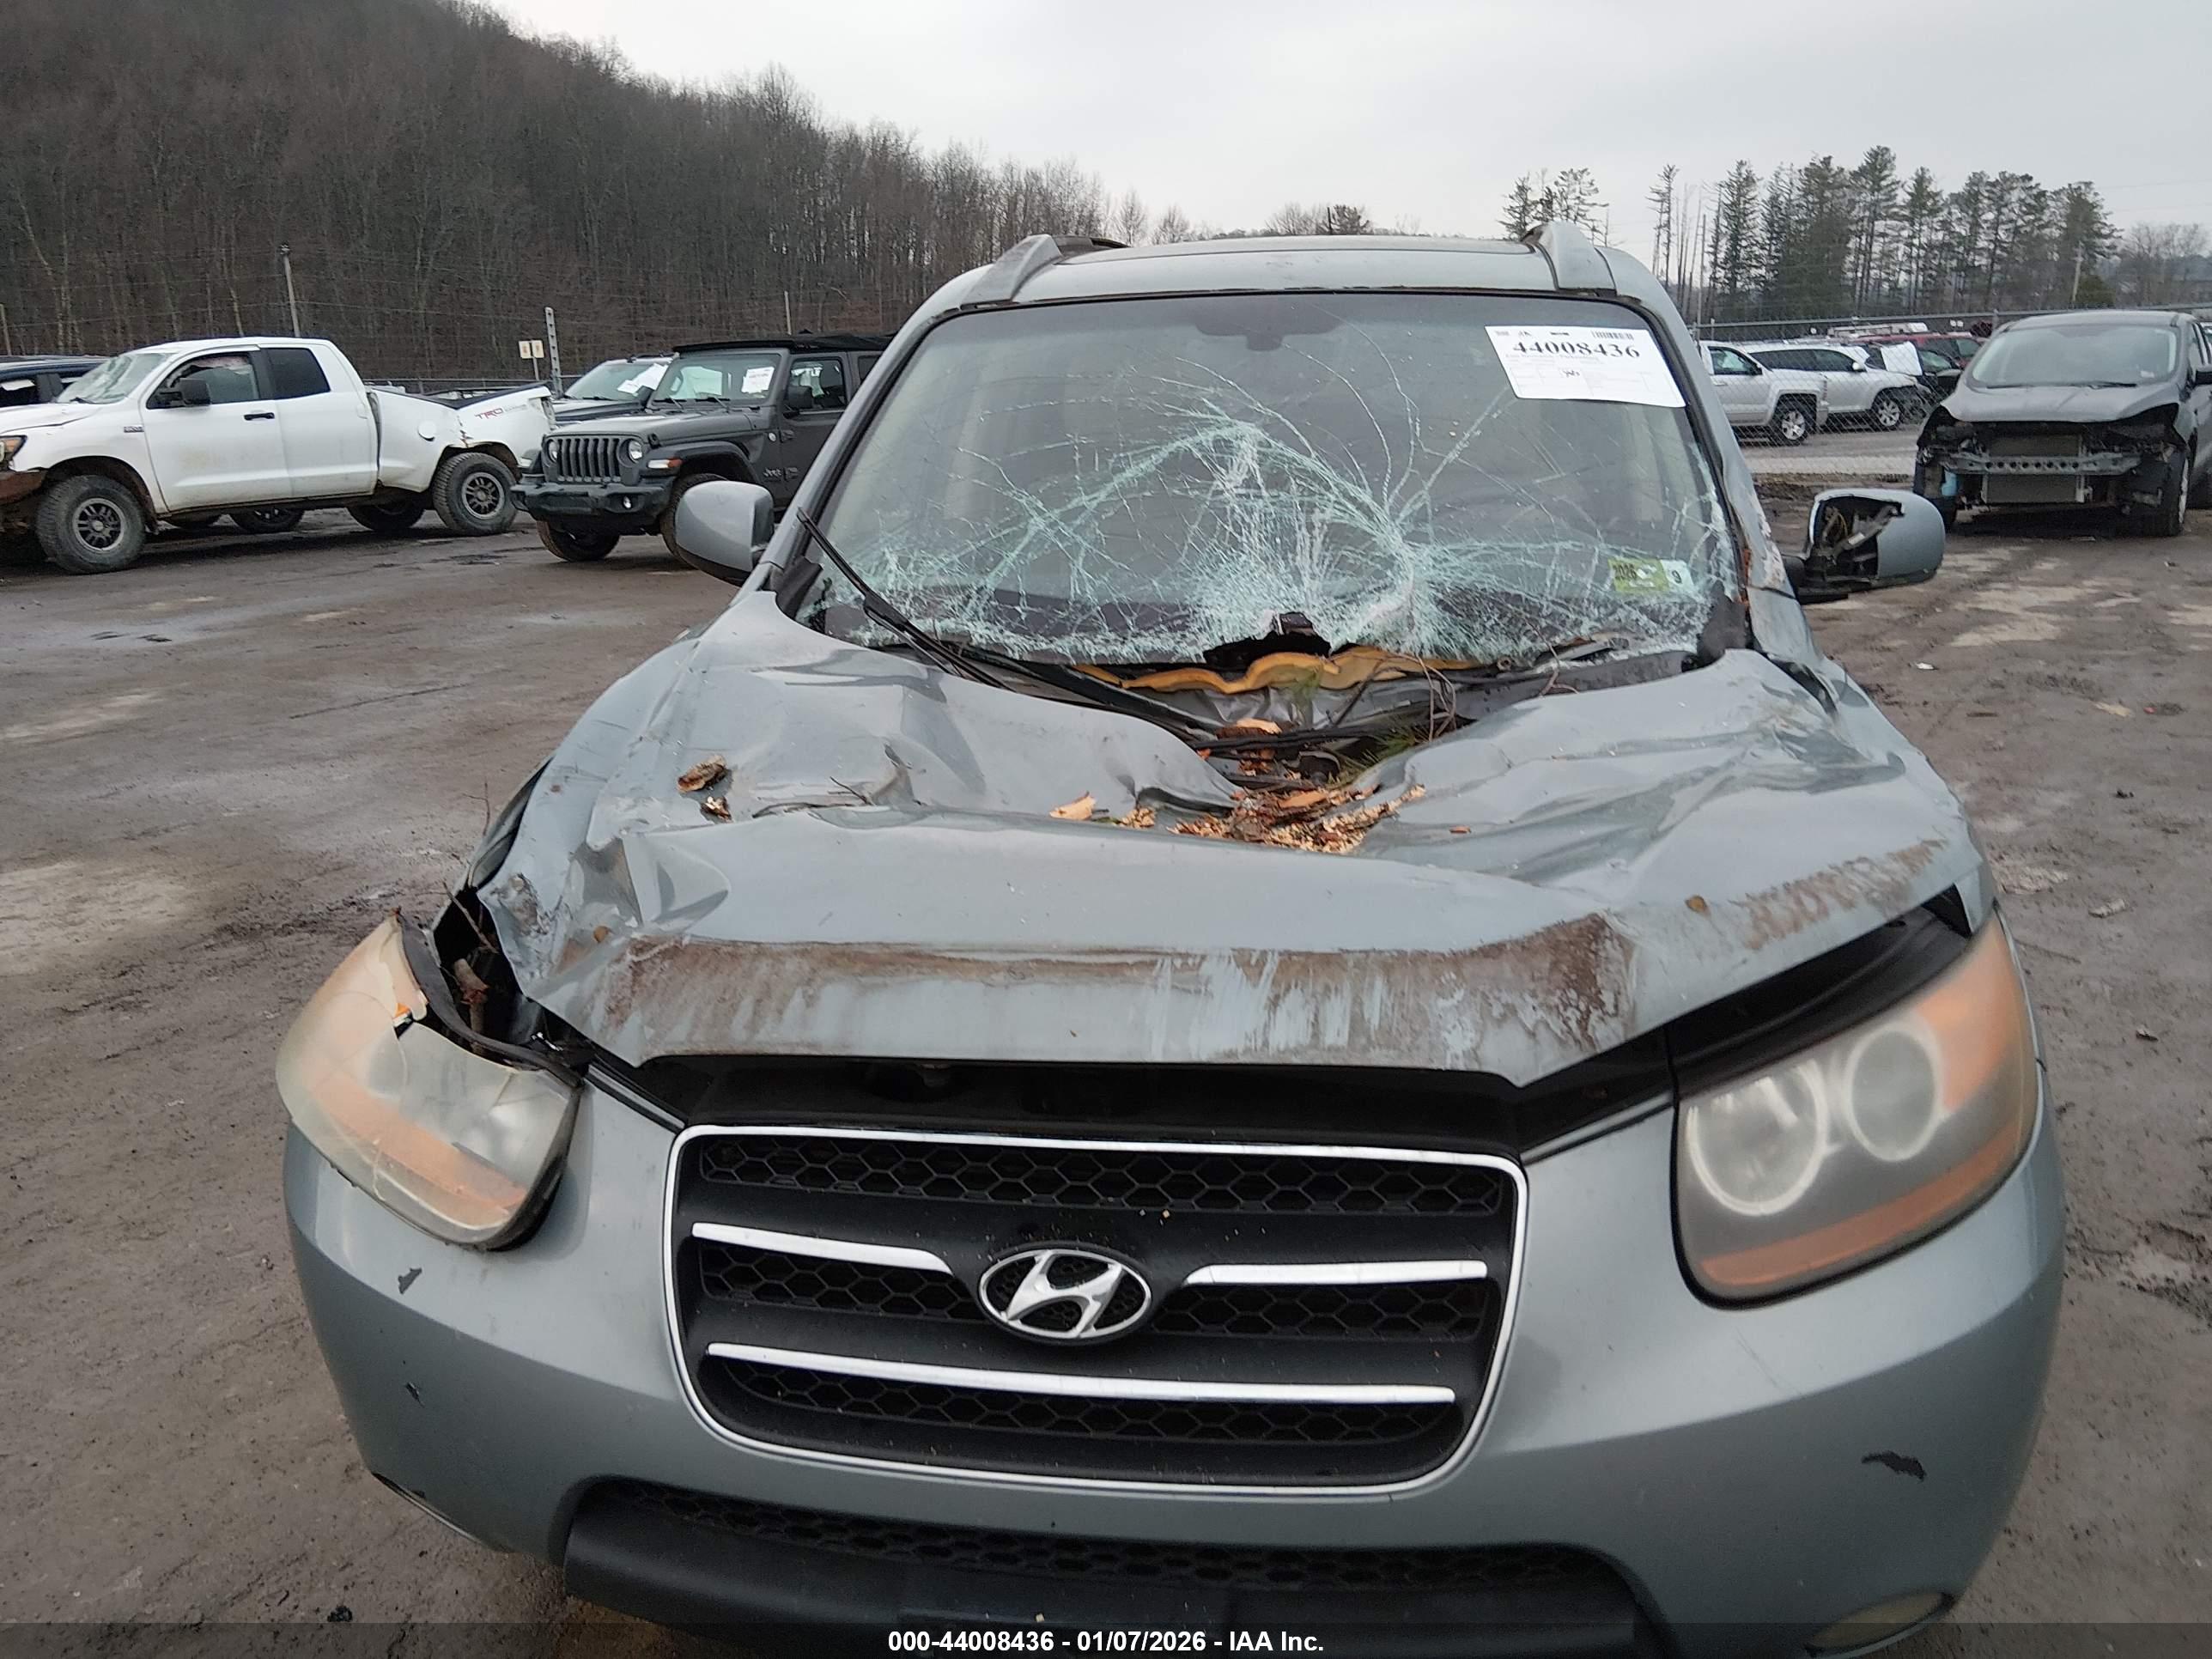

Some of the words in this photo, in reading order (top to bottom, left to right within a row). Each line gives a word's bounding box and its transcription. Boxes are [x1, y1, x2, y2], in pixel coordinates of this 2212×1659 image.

[1512, 340, 1640, 359] 44008436
[1613, 563, 1638, 581] 2026
[1671, 569, 1683, 585] 9
